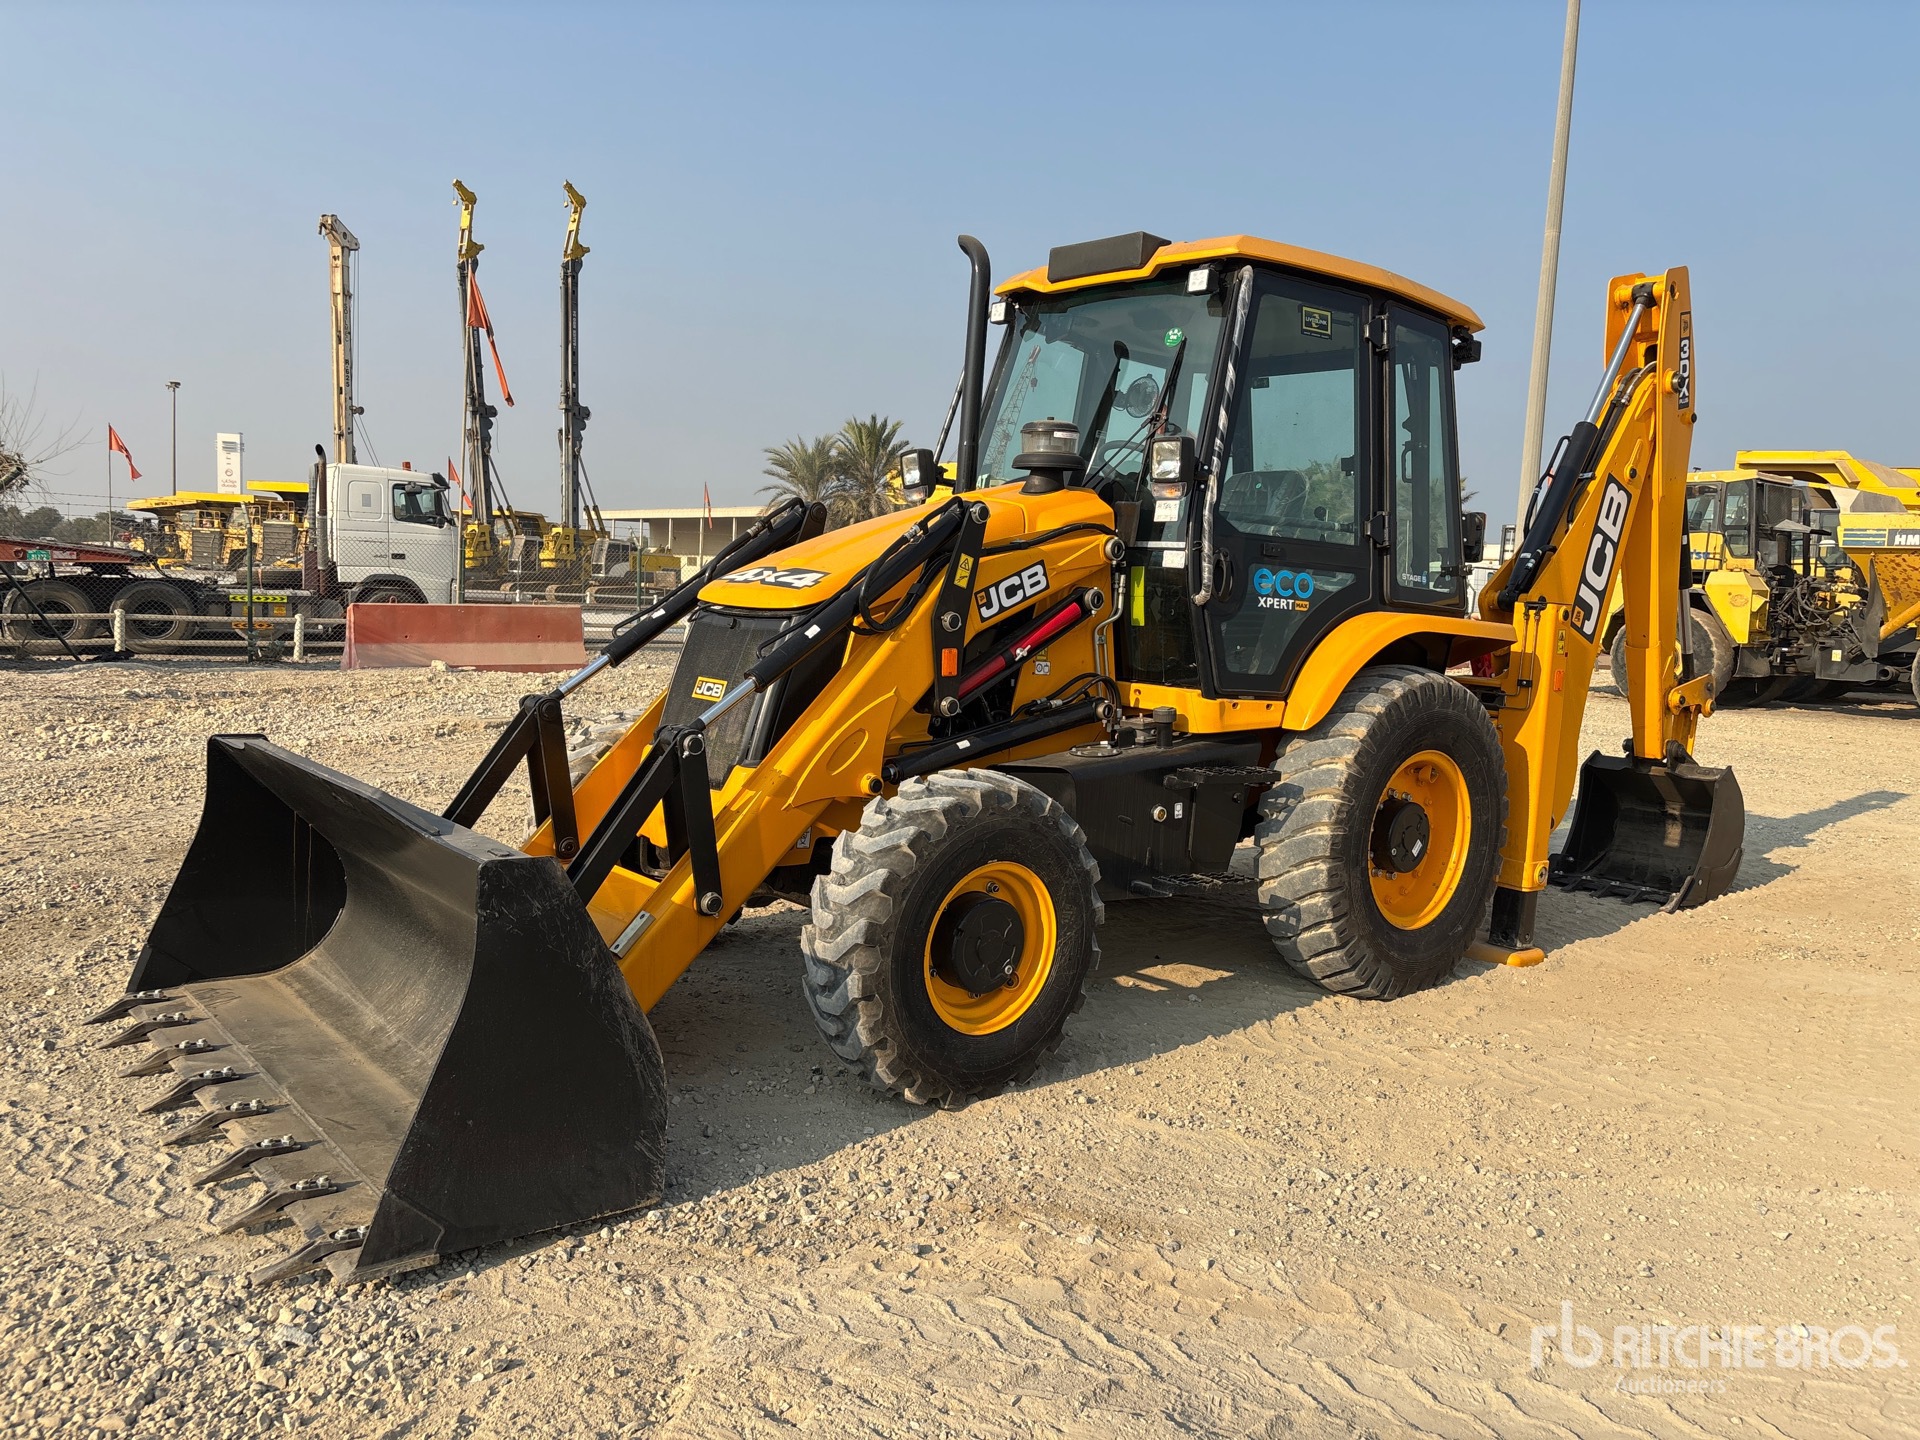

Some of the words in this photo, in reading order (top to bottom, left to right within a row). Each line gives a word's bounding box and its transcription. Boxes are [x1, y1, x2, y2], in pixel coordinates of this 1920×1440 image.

[1582, 482, 1628, 635] JCB
[1253, 568, 1314, 599] eco
[1401, 573, 1422, 582] STAGE
[980, 564, 1047, 618] JCB
[1257, 596, 1295, 611] XPERT
[695, 681, 723, 697] JCB
